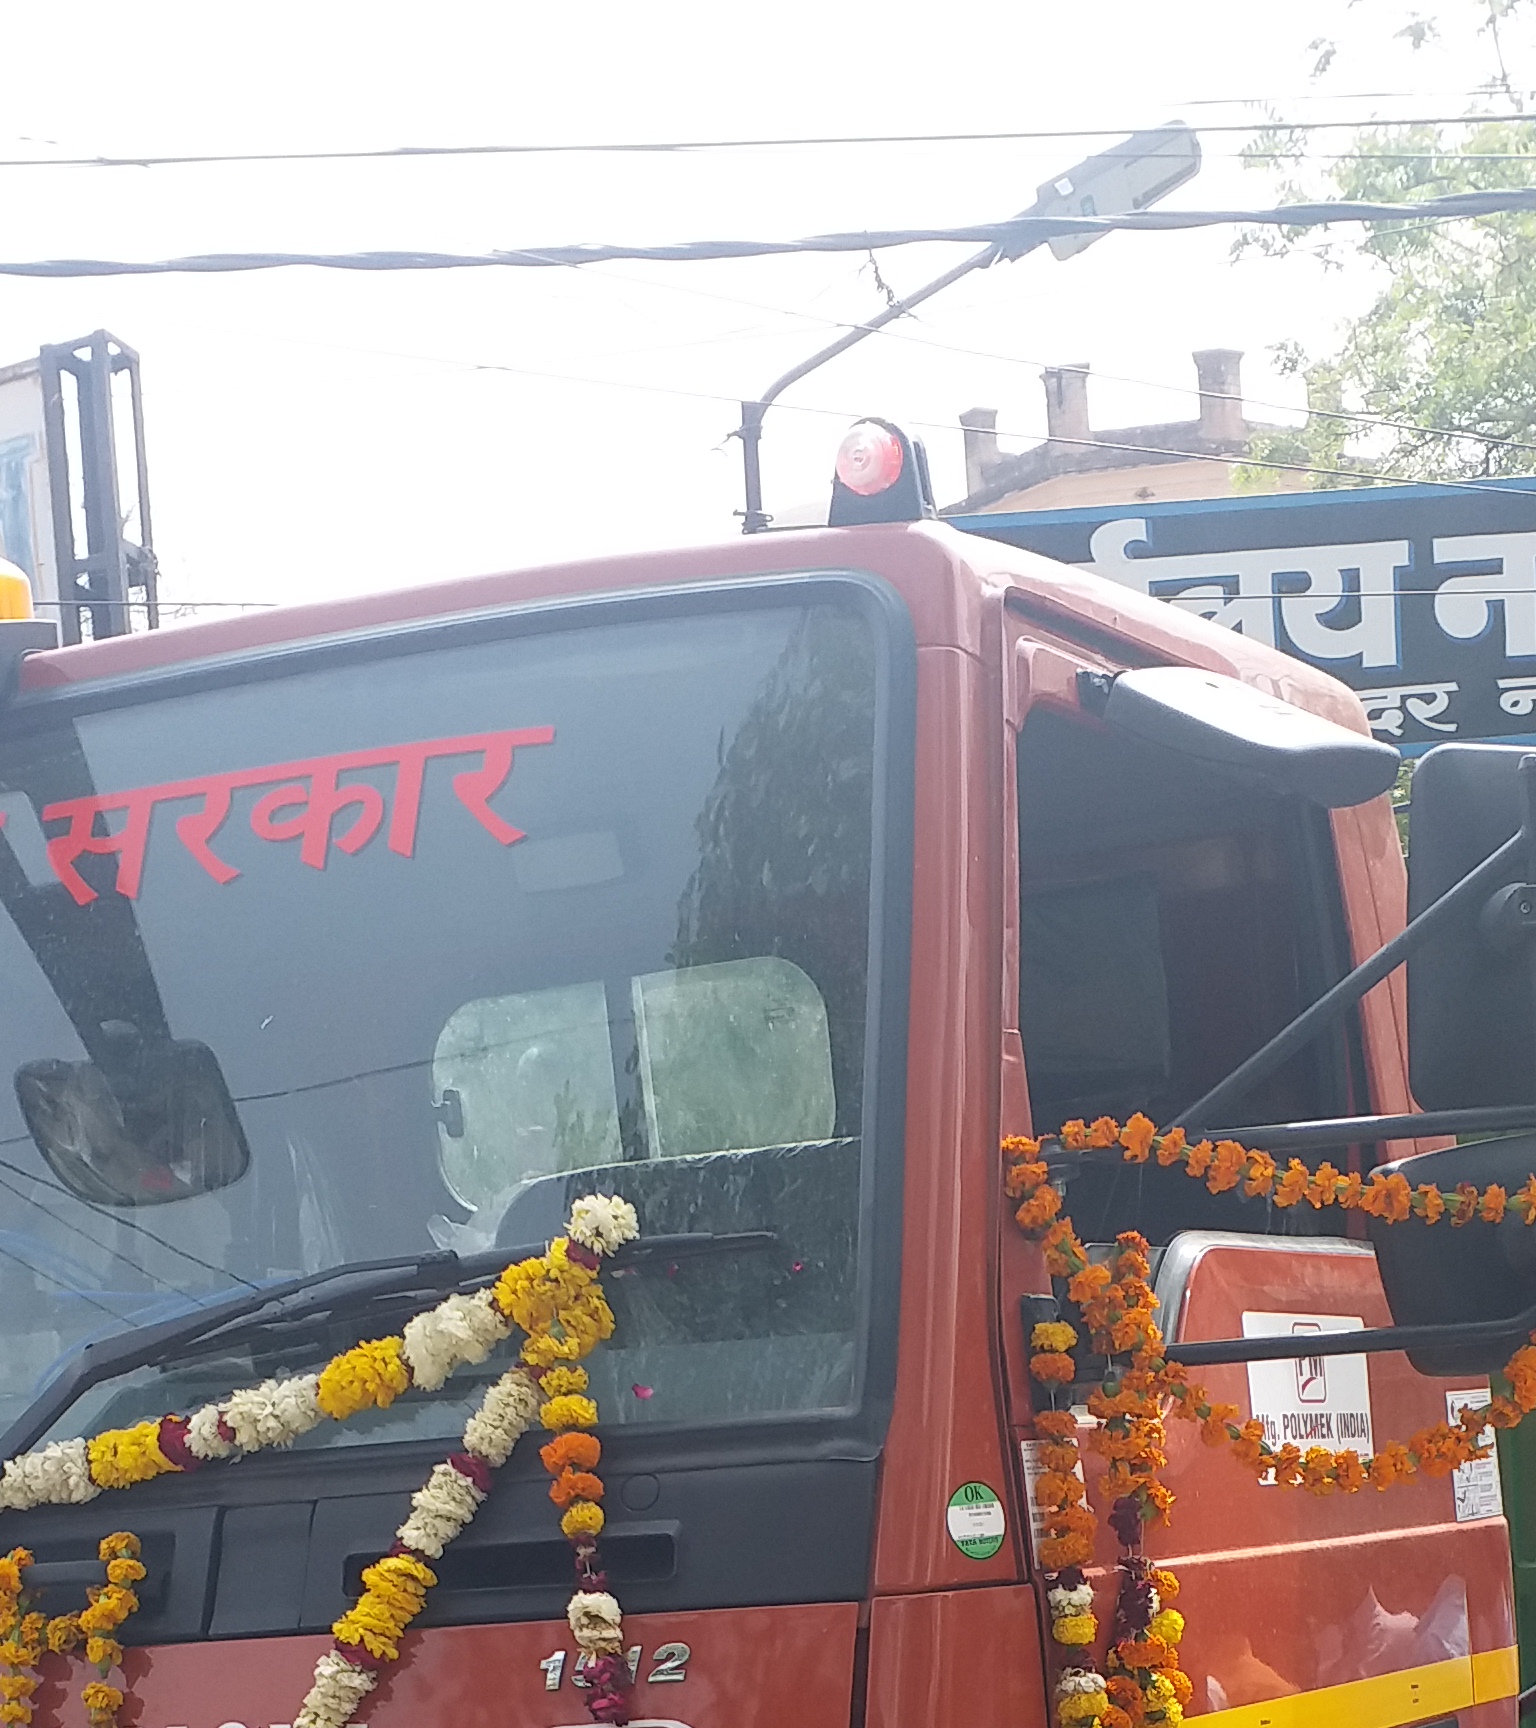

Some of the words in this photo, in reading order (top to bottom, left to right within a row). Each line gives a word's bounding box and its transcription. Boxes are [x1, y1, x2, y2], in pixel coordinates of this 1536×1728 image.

[41, 724, 556, 907] सरकार
[1282, 1413, 1334, 1441] POLYMEK
[1336, 1412, 1370, 1445] (INDIA)
[964, 1485, 984, 1503] OK
